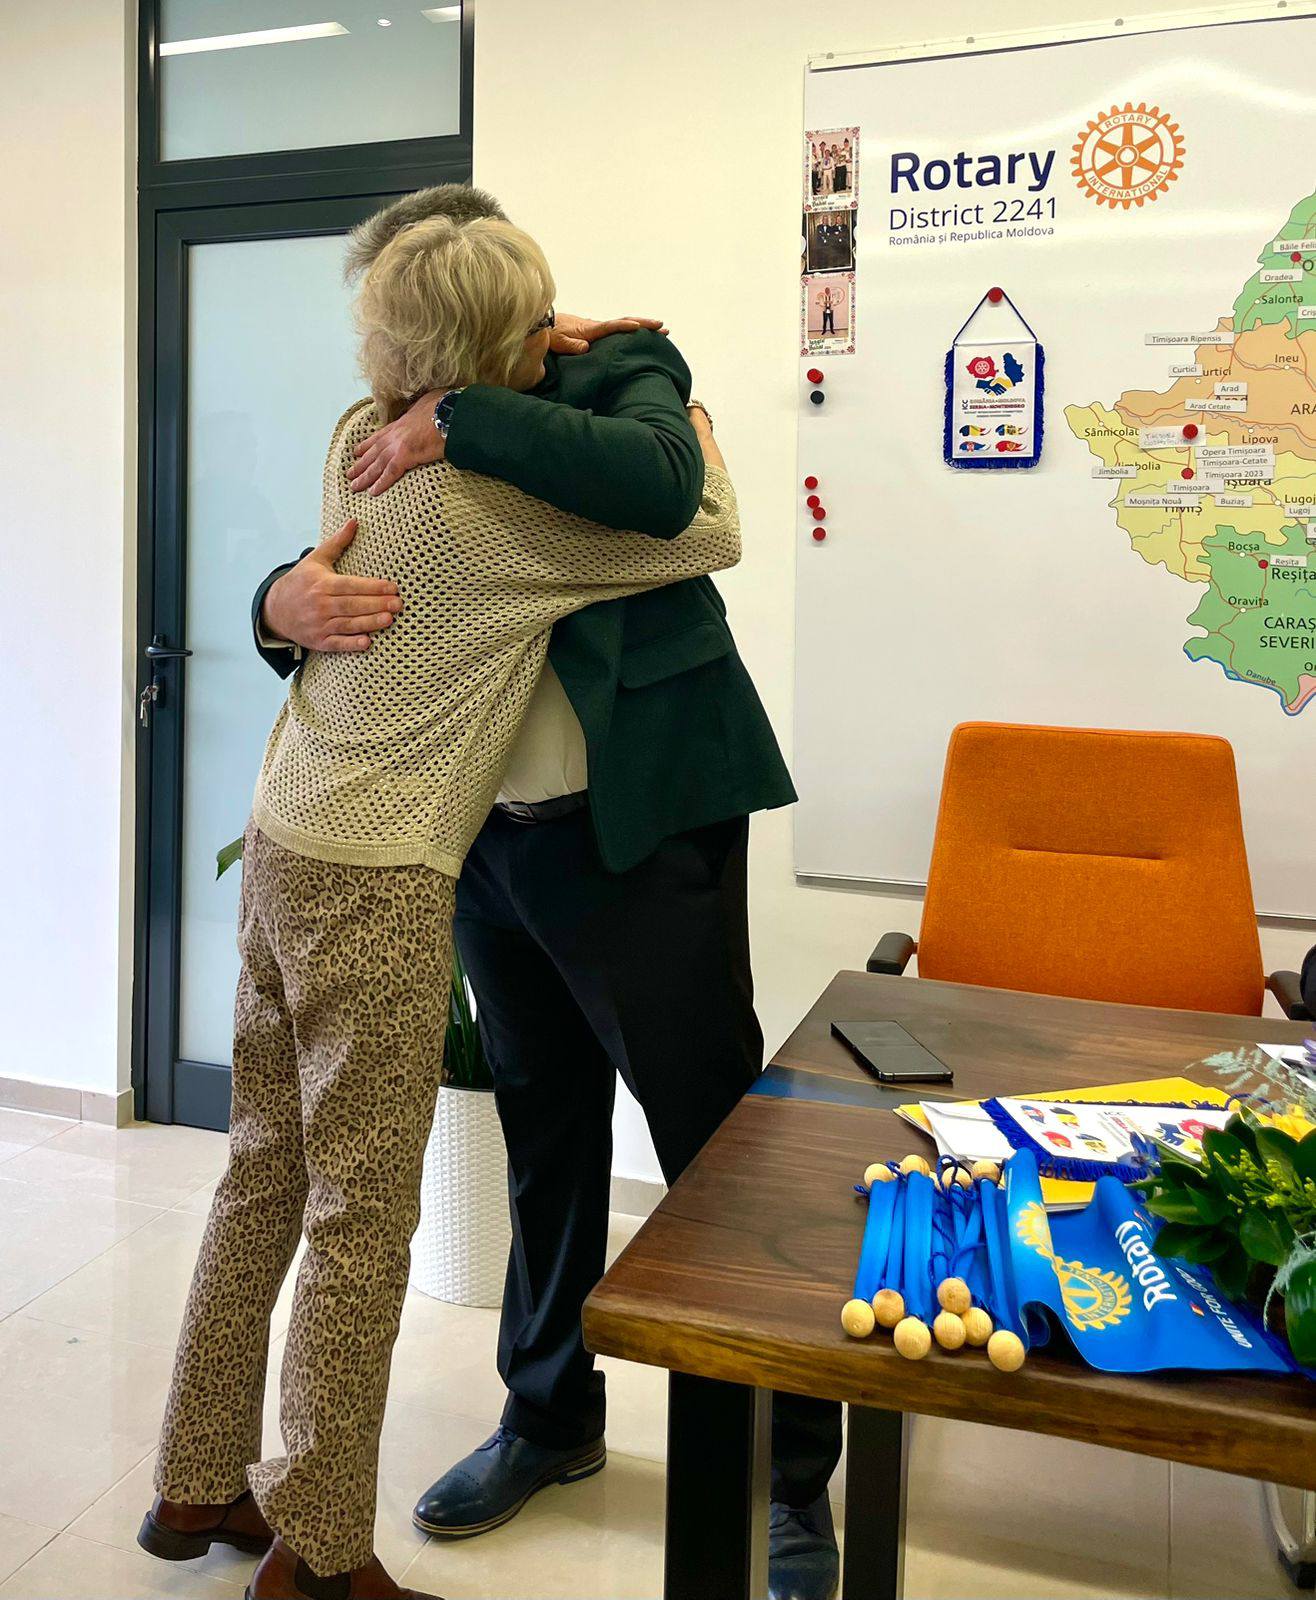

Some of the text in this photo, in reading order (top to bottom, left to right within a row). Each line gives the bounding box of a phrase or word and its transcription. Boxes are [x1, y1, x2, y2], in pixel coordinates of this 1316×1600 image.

[1105, 114, 1151, 128] ROTARY
[890, 150, 1056, 193] Rotary
[1088, 169, 1168, 198] INTERNATIONAL
[890, 197, 1056, 230] District 2241
[889, 234, 936, 245] România
[950, 229, 1003, 242] Republica
[1006, 226, 1054, 238] Moldova
[1264, 273, 1294, 281] Oradea
[1261, 294, 1304, 304] Salonta
[1152, 335, 1222, 343] Timișoara Ripensis
[1275, 354, 1299, 363] Ineu
[1172, 366, 1232, 376] Curtici urtici
[1241, 434, 1279, 445] Lipova
[1228, 447, 1266, 455] Timișoara
[1173, 484, 1210, 492] Timișoara
[1220, 498, 1246, 506] Buziaș
[1285, 494, 1316, 505] Lugoj
[1289, 507, 1311, 515] Lugoj
[1228, 541, 1260, 553] Bocșa
[1272, 567, 1316, 583] Reșița
[1228, 595, 1269, 608] Oravița
[1246, 669, 1277, 685] Danube
[1115, 1220, 1178, 1312] Rotary
[1215, 1314, 1253, 1349] UNITE
